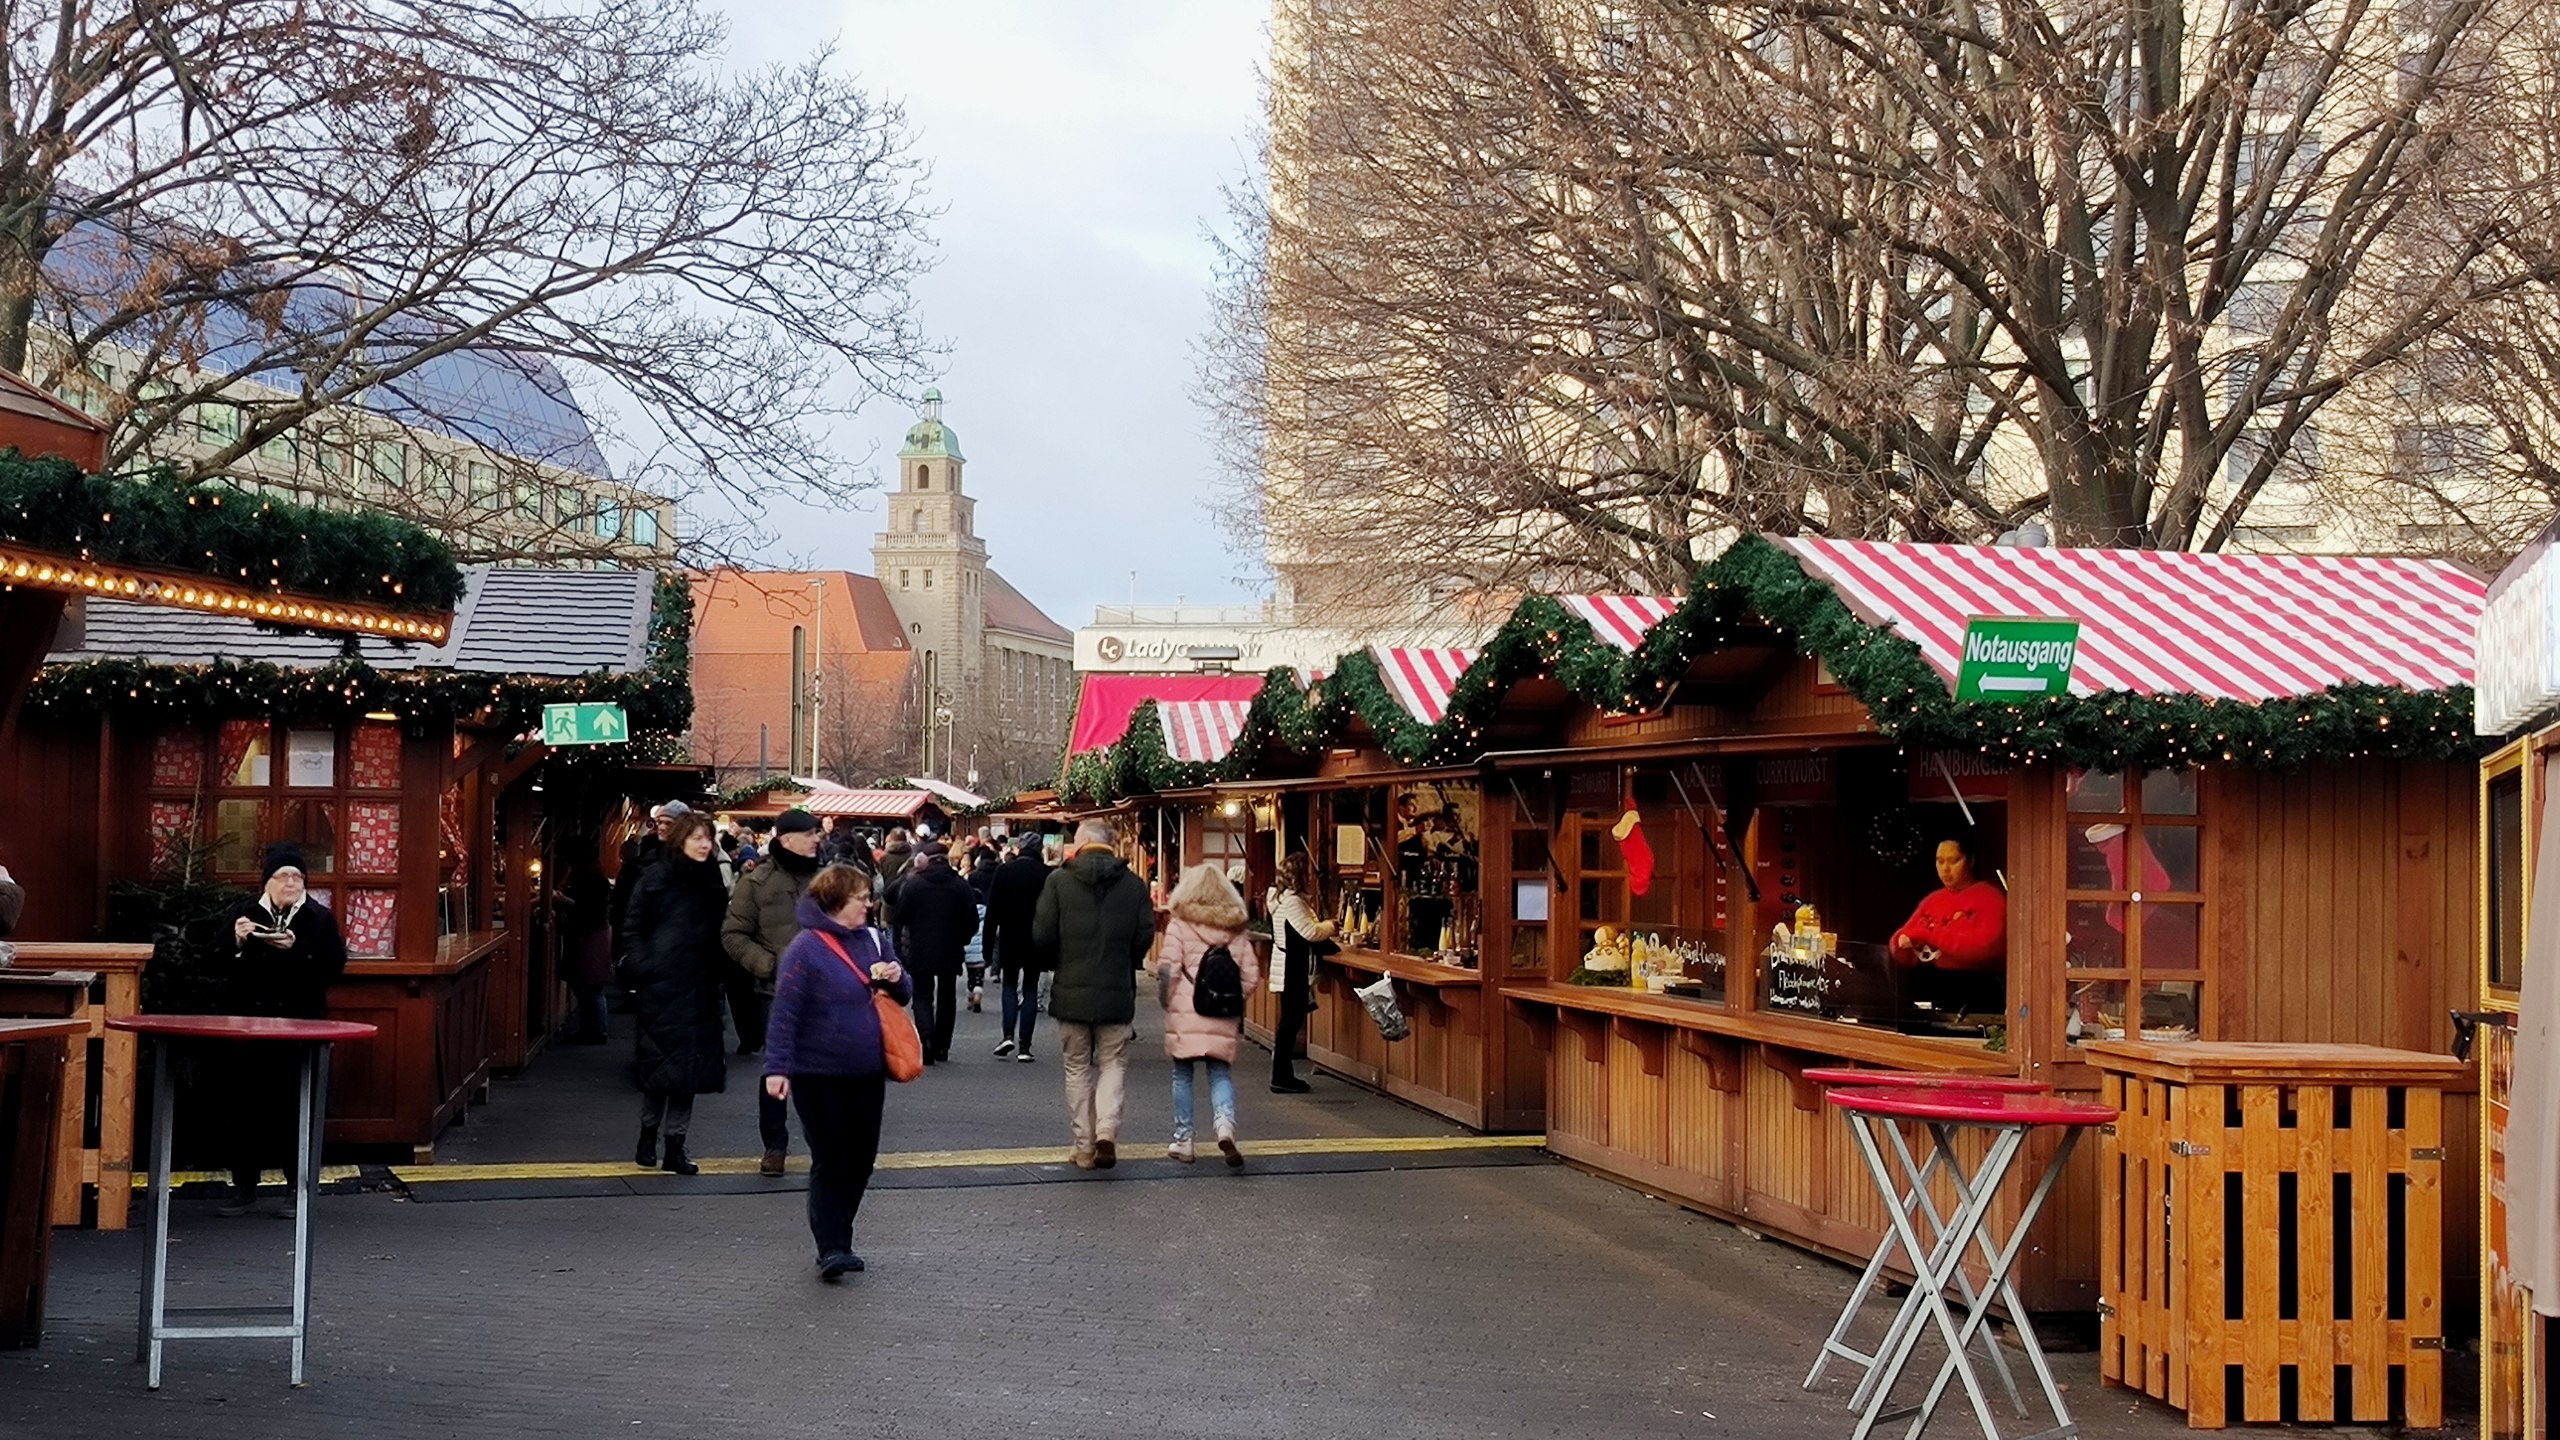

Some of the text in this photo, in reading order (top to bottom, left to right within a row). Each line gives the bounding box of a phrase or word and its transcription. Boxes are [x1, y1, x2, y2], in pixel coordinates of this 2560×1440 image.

[1125, 637, 1263, 663] LadyCNY
[1966, 632, 2073, 671] Notausgang
[1683, 763, 1722, 788] KALER
[1756, 756, 1828, 785] CURRYWURST
